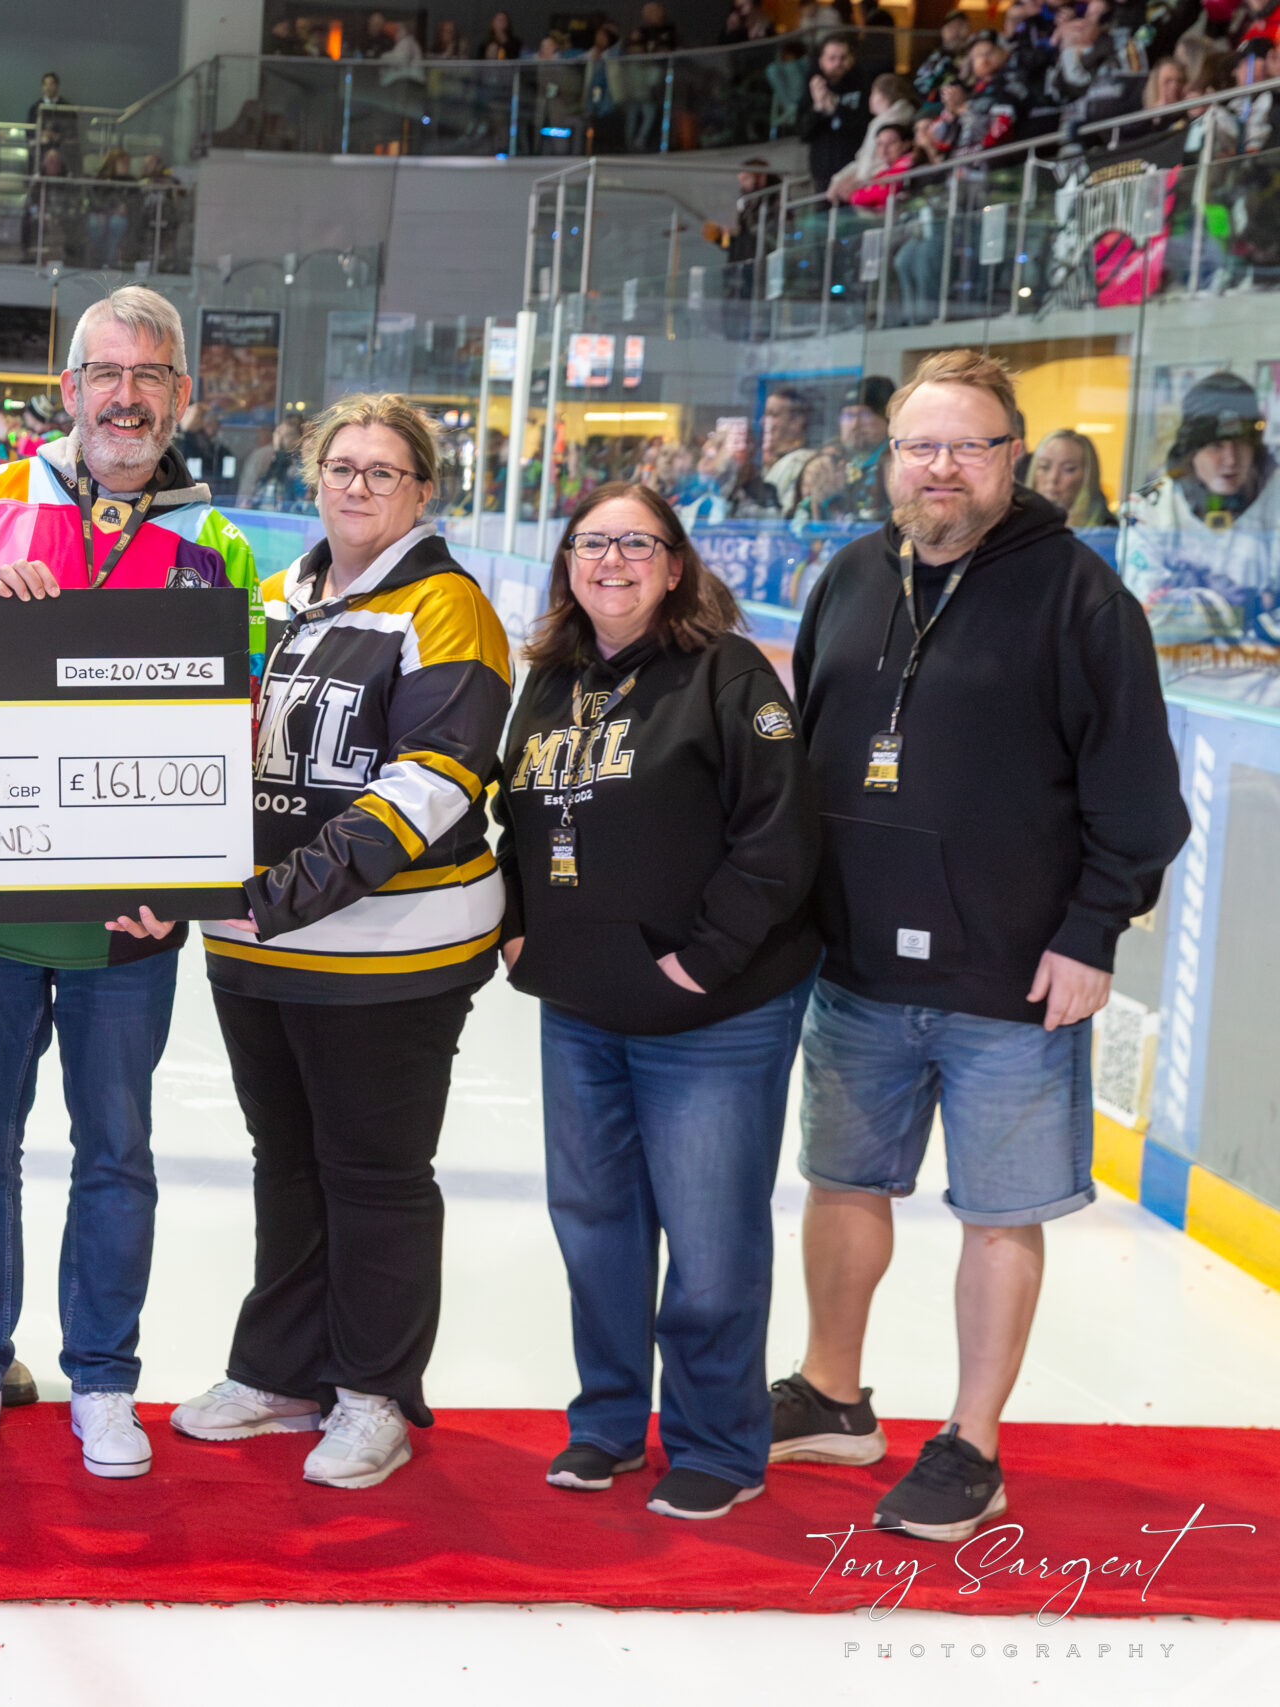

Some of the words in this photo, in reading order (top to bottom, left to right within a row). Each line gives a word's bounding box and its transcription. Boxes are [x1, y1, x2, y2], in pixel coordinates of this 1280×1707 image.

[65, 666, 109, 679] Date:
[510, 718, 635, 792] MKL
[9, 786, 41, 798] GBP
